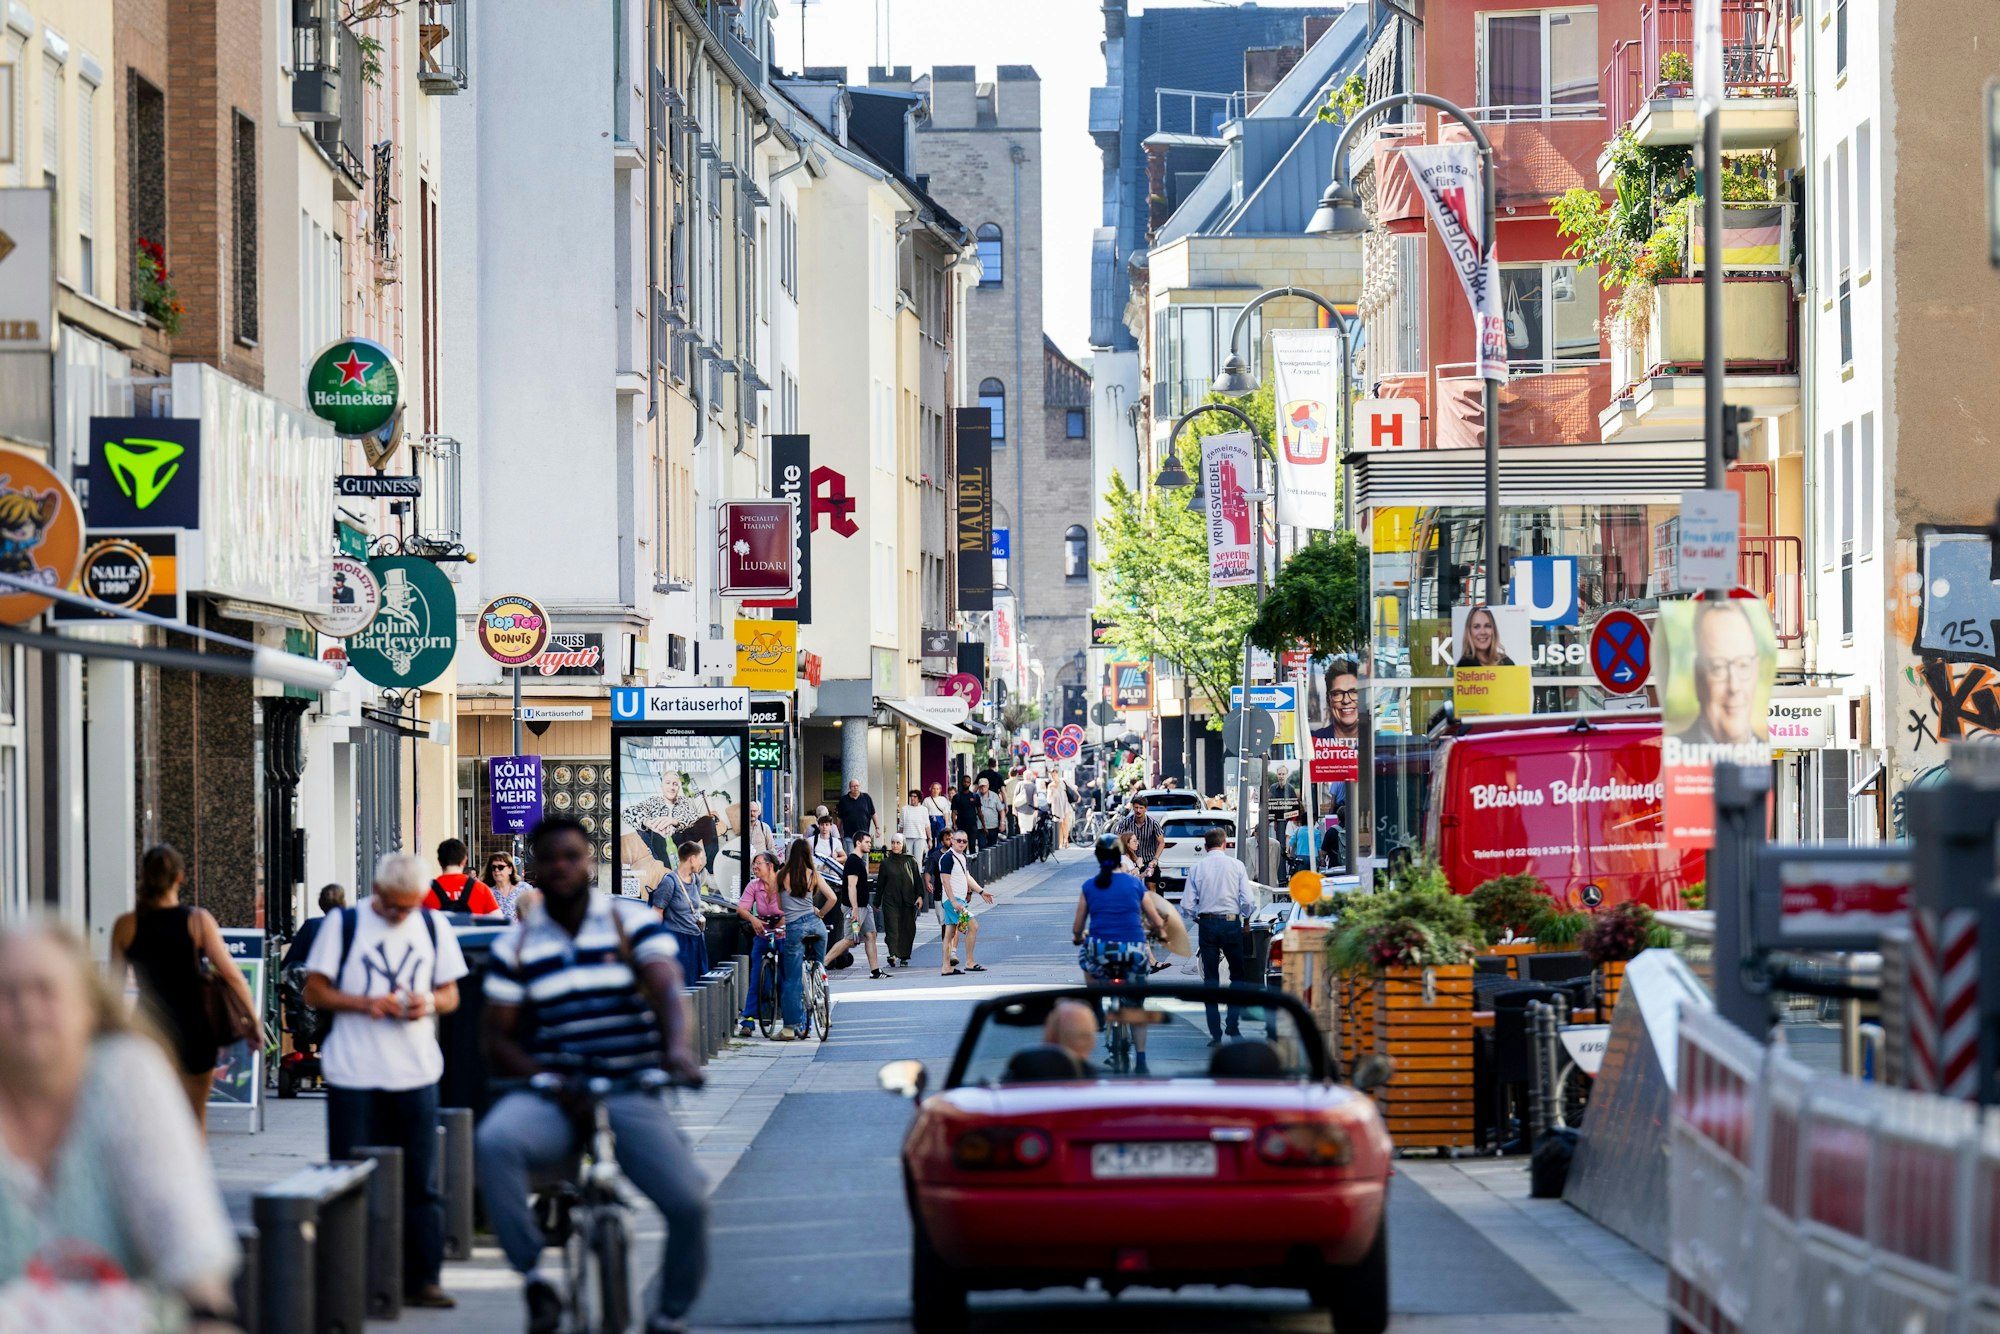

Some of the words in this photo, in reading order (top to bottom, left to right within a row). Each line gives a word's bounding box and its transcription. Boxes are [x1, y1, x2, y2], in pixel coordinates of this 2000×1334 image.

[1436, 177, 1456, 187] fürs
[314, 391, 392, 406] Heineken
[1371, 414, 1403, 446] H
[1207, 444, 1249, 460] gemeinsam
[343, 478, 417, 493] GUINNESS
[959, 467, 983, 552] MAUEL
[1209, 461, 1224, 546] VRINGSVEEDEL
[92, 566, 140, 579] NAILS
[333, 562, 375, 604] MORETTI
[1514, 560, 1572, 621] U
[493, 597, 533, 609] DELICIOUS
[365, 617, 412, 637] John
[352, 632, 451, 655] Barleycorn
[494, 633, 531, 644] DONUTS
[772, 645, 792, 653] DOG
[492, 653, 532, 664] MEMORIES
[532, 646, 599, 675] ayati
[1456, 671, 1496, 682] Stefanie
[1119, 689, 1146, 699] ALDI
[1457, 685, 1488, 695] Ruffen
[1235, 694, 1276, 702] Einhnstraße
[617, 692, 638, 717] U
[651, 697, 743, 711] Kartäuserhof
[653, 736, 687, 746] GEWINNE
[636, 748, 725, 760] WOHNZIMMERKONZERT
[750, 752, 777, 762] OSK
[495, 761, 535, 777] KÖLN
[496, 778, 536, 790] KANN
[496, 791, 536, 803] MEHR
[1470, 783, 1544, 809] Bläsius
[1550, 778, 1663, 805] Bedachunge
[509, 820, 524, 828] Volt
[1472, 850, 1504, 859] Telefon
